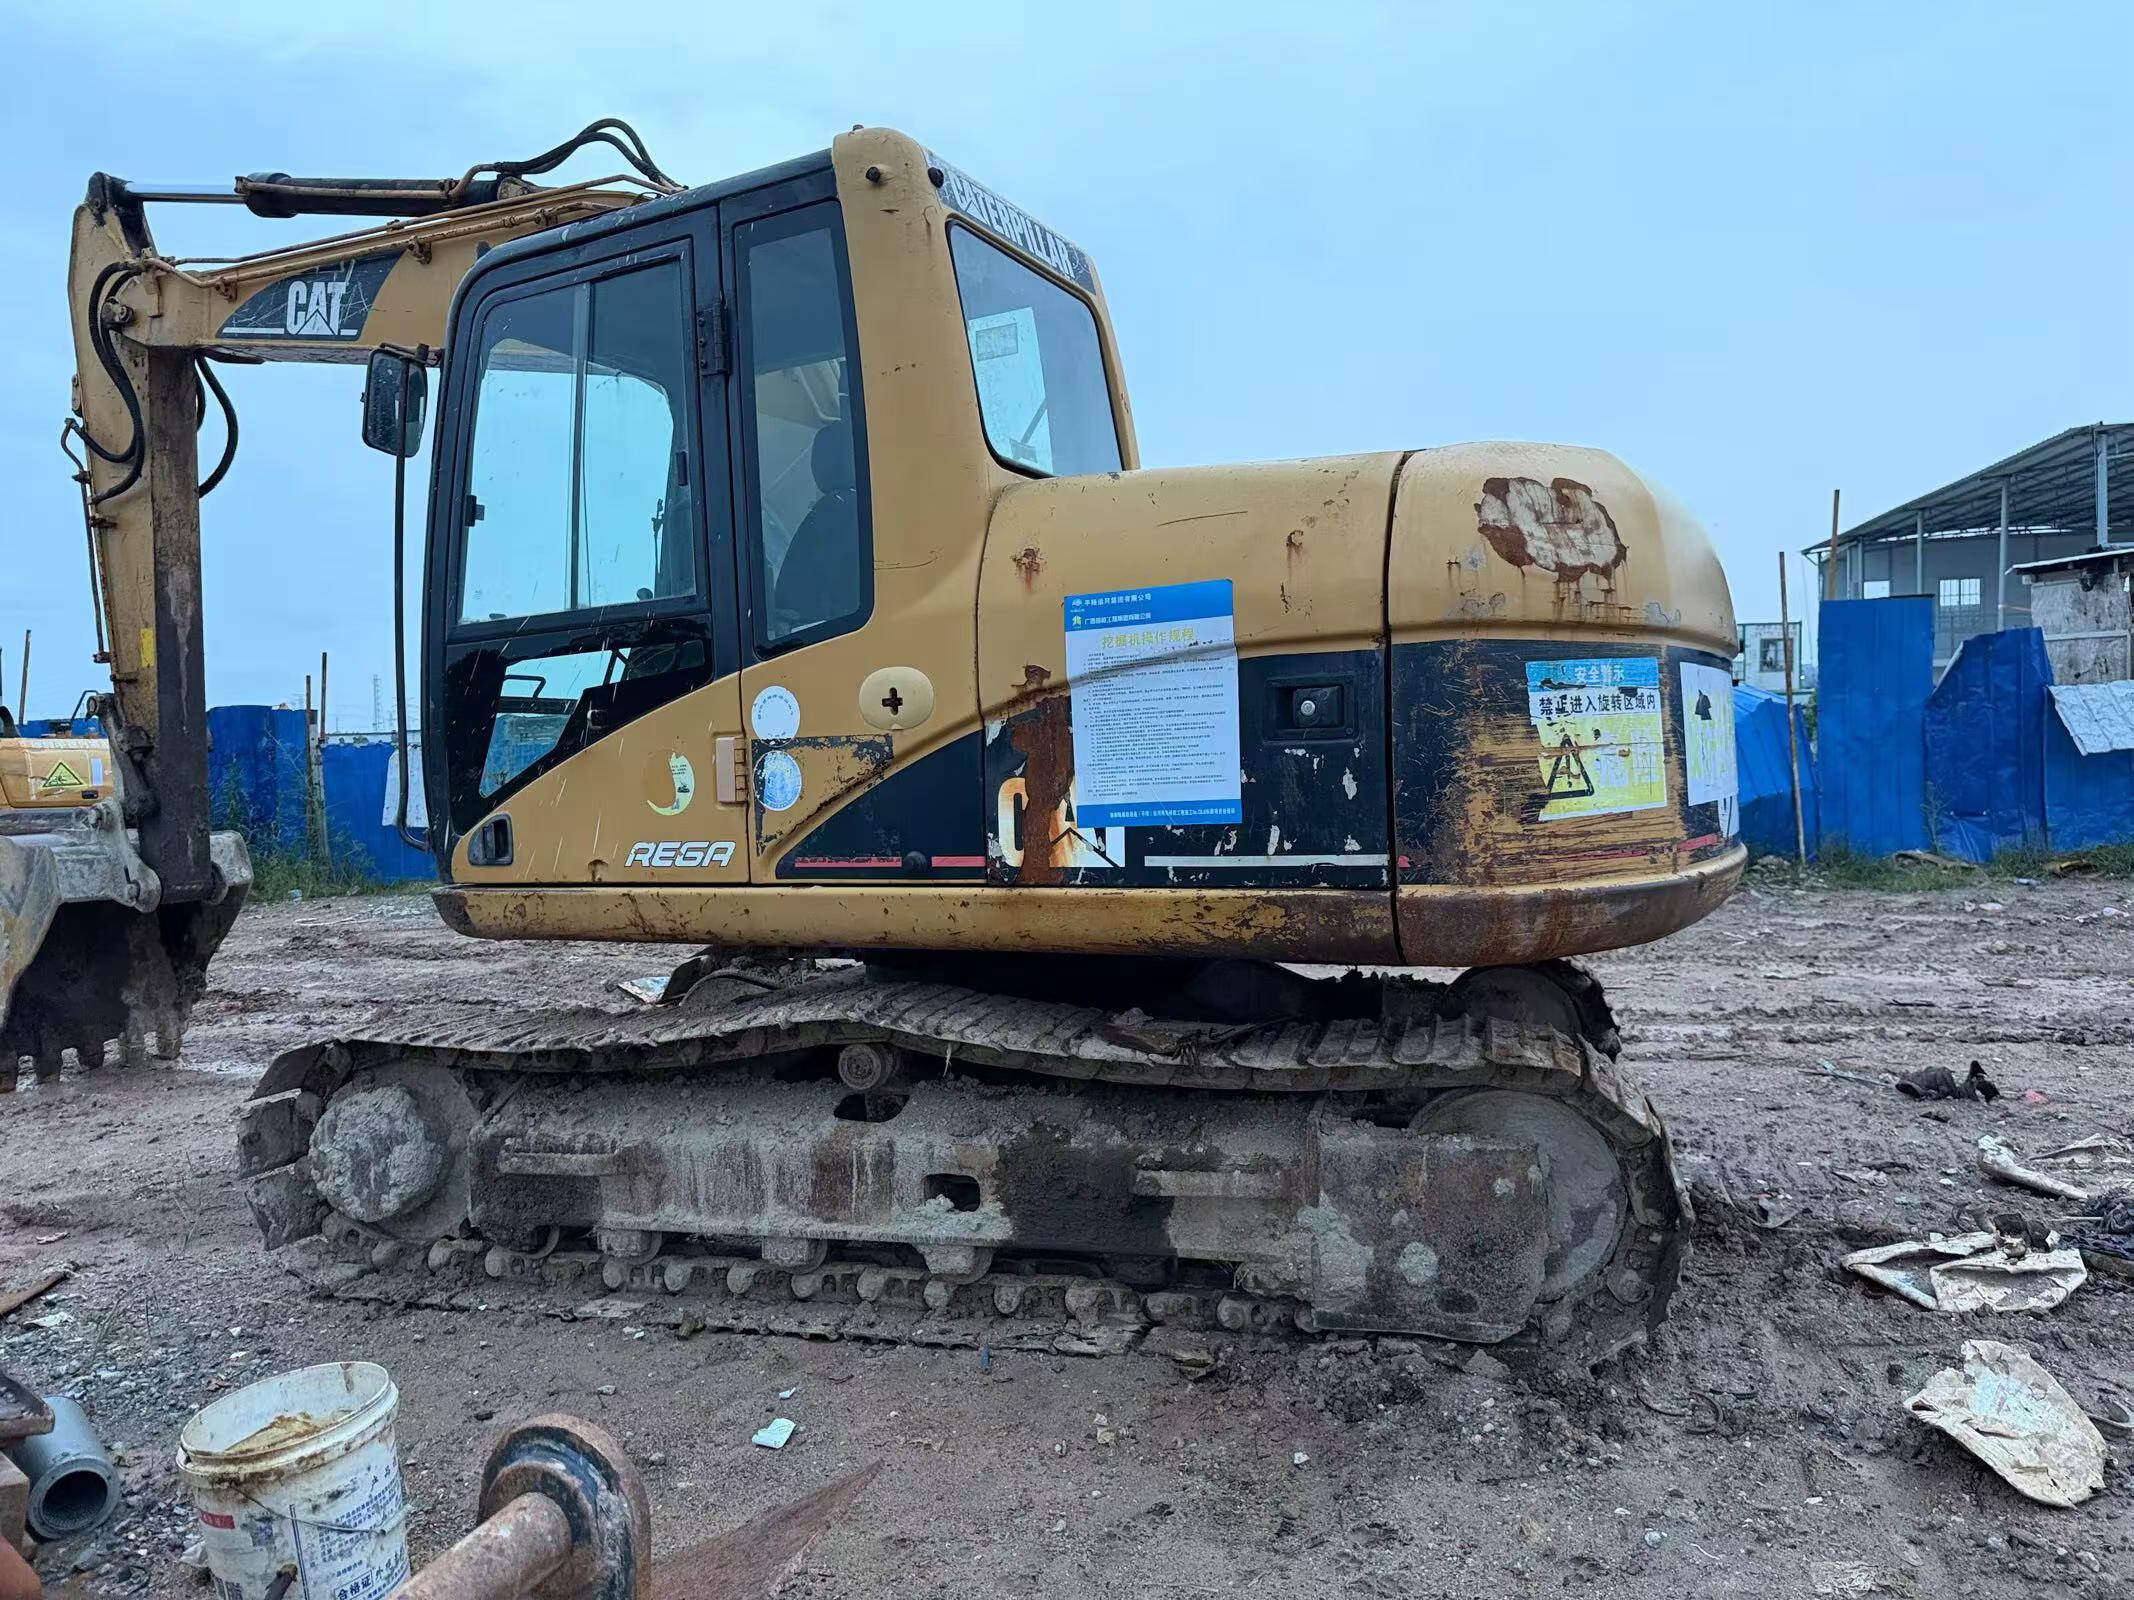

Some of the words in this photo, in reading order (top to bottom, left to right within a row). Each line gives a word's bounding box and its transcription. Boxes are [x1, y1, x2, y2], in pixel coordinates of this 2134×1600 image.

[947, 172, 1075, 279] CATERPILLAR
[286, 280, 346, 335] CAT
[1539, 693, 1656, 715] 禁止进入旋转区域内
[625, 841, 737, 868] REGA
[337, 1574, 372, 1600] 合格证
